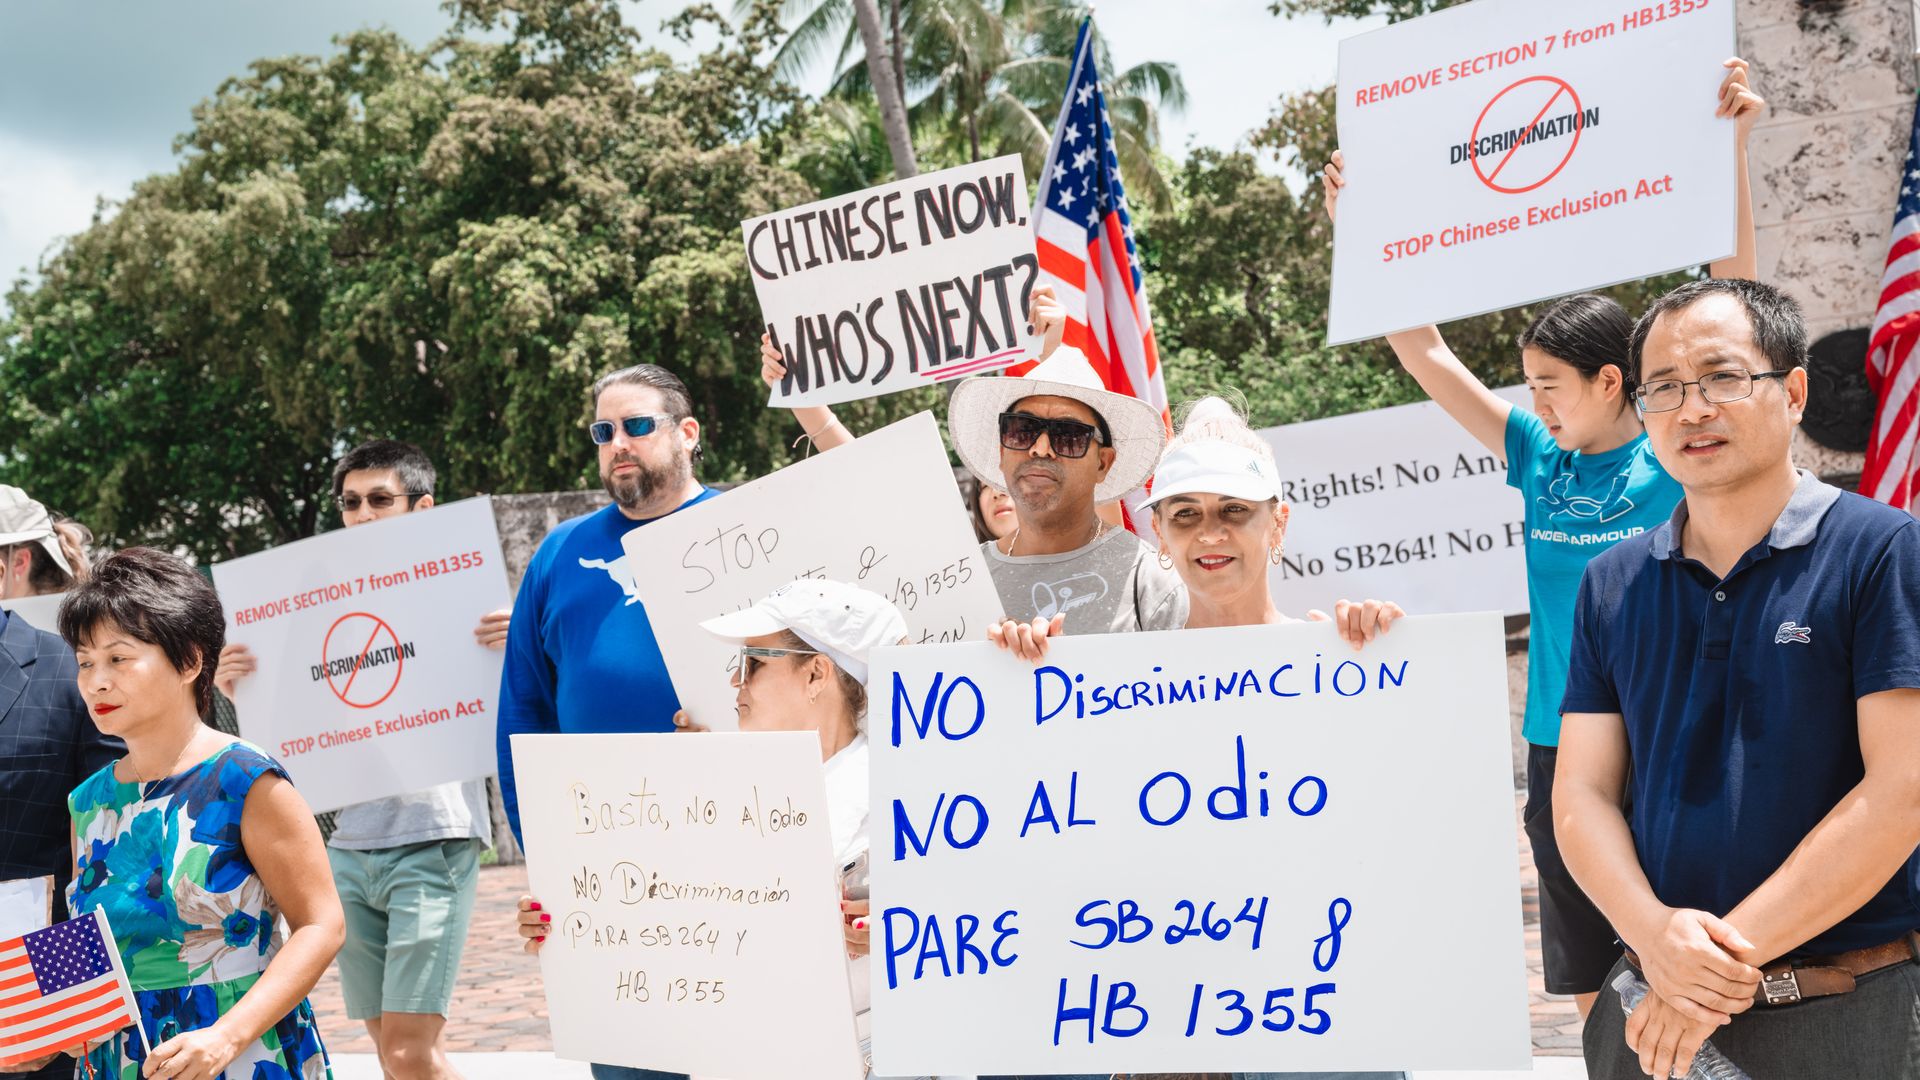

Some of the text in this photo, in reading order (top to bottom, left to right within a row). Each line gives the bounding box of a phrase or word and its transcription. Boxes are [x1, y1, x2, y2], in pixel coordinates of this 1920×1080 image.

[1355, 68, 1442, 107] REMOVE
[1447, 41, 1537, 81] SECTION
[1544, 37, 1557, 55] 7
[1563, 21, 1615, 49] from
[1450, 107, 1600, 164] DISCRIMINATION
[749, 191, 908, 280] CHINESE
[1383, 174, 1673, 262] STOP Chinese Exclusion Act
[768, 253, 1039, 397] WHO'S NEXT?
[1281, 466, 1384, 509] Rights!
[1393, 460, 1440, 488] No
[235, 550, 484, 627] REMOVE SECTION 7 from HB1355
[682, 524, 779, 594] STOP
[925, 556, 972, 596] 1355
[1281, 553, 1324, 580] No
[1334, 535, 1437, 573] SB264!
[1448, 529, 1494, 557] No
[310, 641, 416, 682] DISCRIMINATION
[281, 698, 486, 758] STOP Chinese Exclusion Act
[891, 671, 985, 747] NO
[568, 777, 670, 835] Basta,
[686, 796, 717, 824] NO
[893, 793, 990, 862] NO
[1020, 771, 1096, 838] AL
[573, 866, 602, 902] NO
[882, 905, 1020, 989] PARE
[616, 970, 726, 1004] HB 1355
[1053, 974, 1337, 1046] HB 1355
